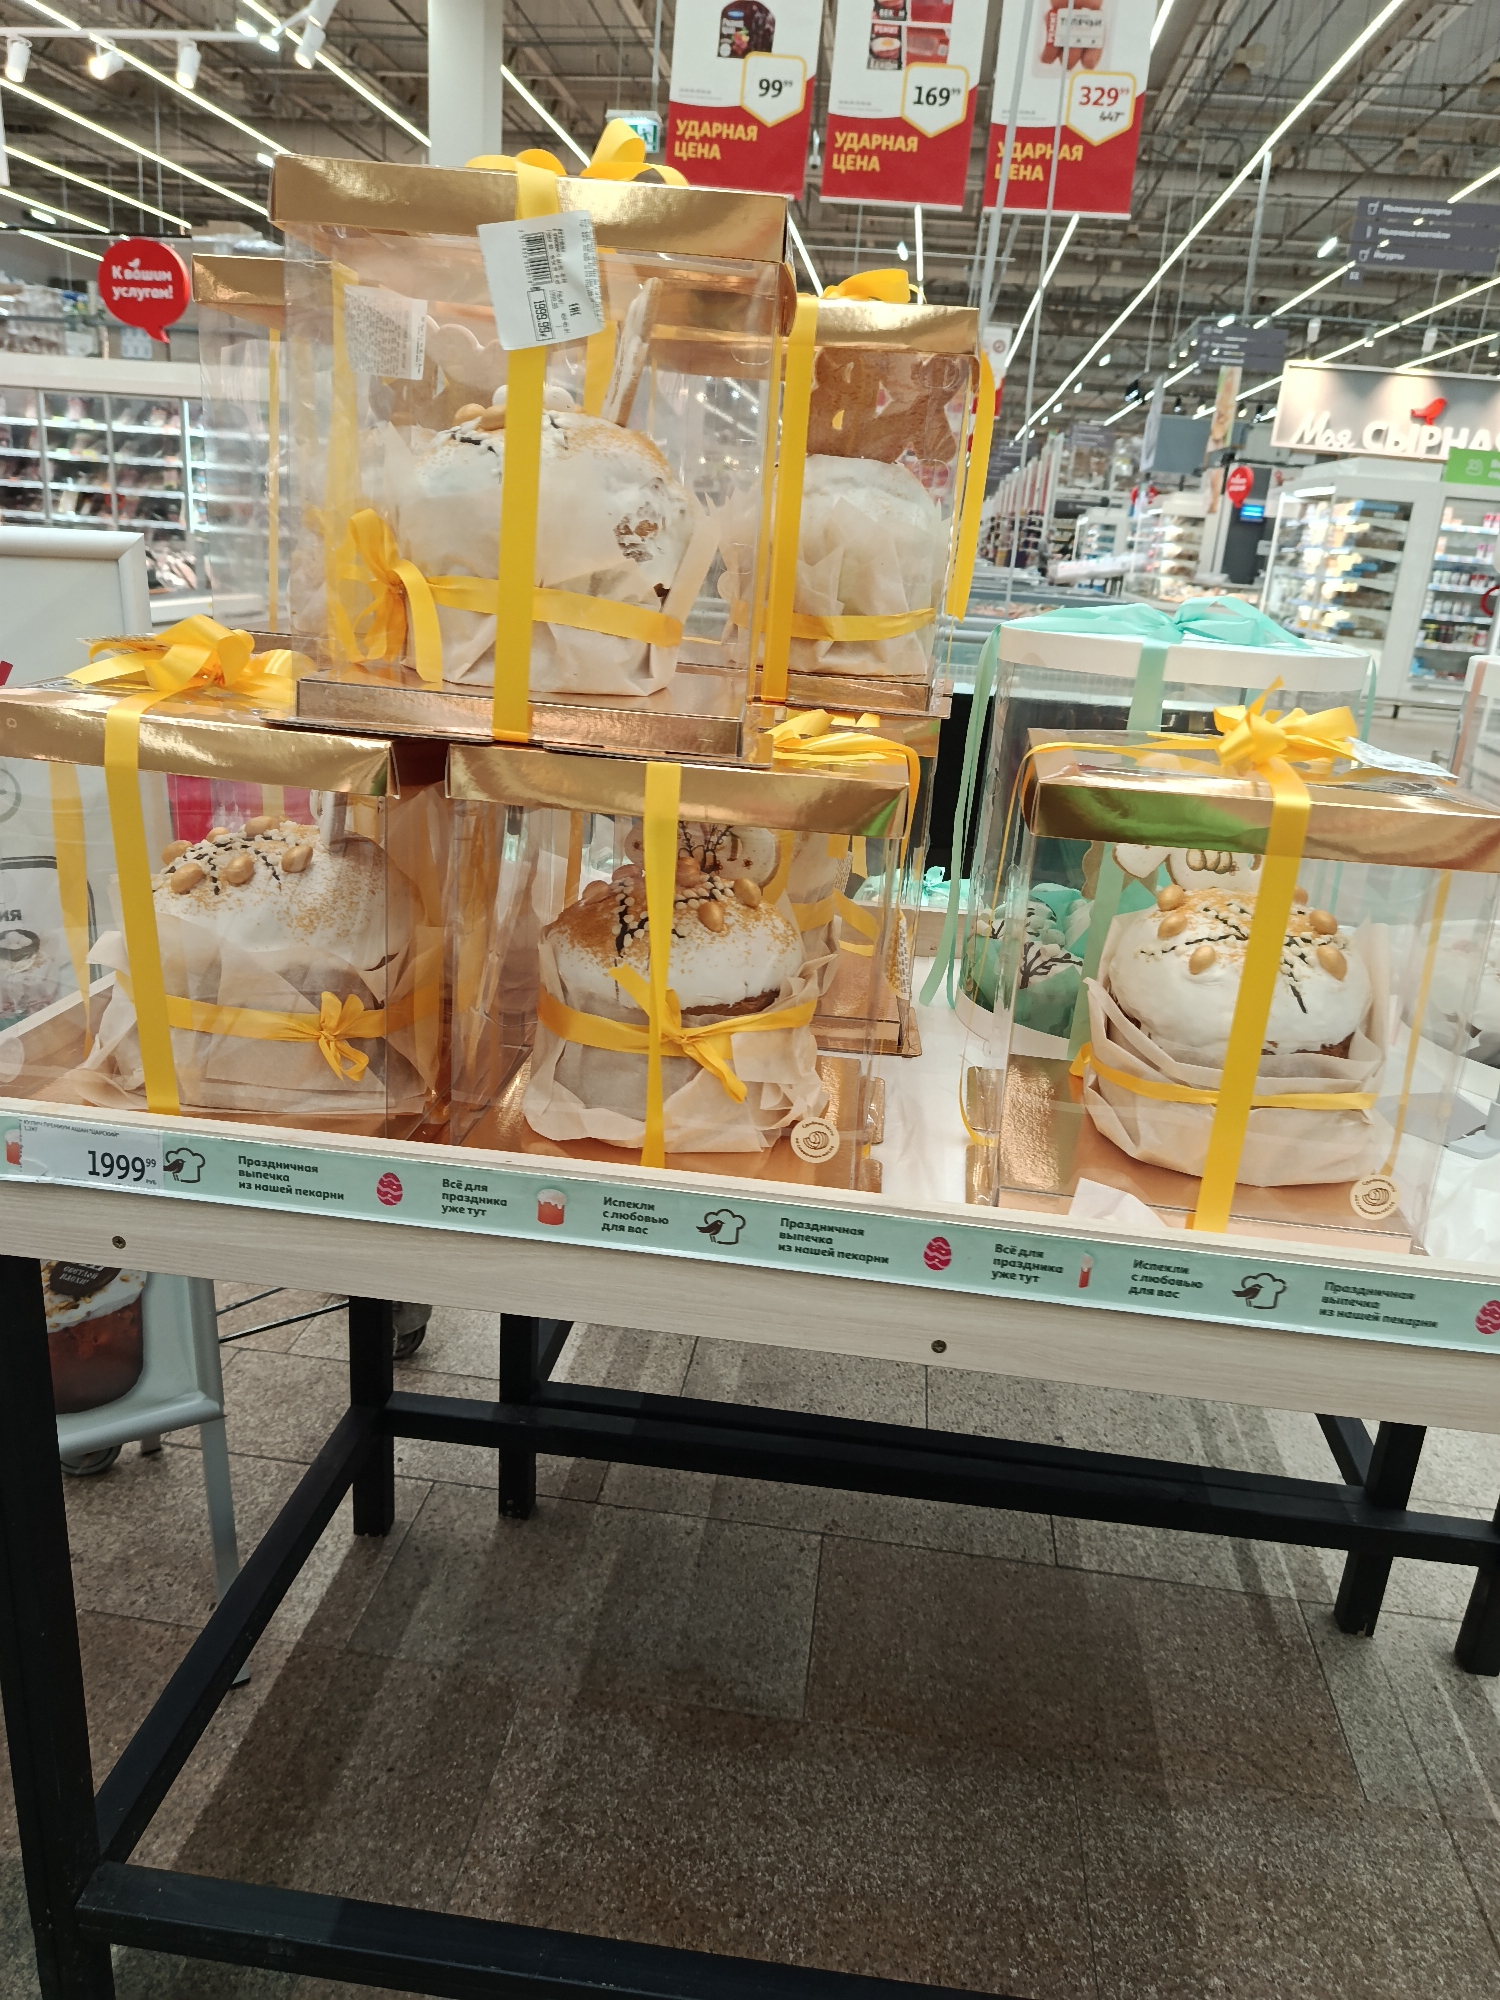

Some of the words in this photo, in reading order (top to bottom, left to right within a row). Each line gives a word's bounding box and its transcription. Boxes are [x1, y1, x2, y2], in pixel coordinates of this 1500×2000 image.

[758, 78, 783, 98] 99
[913, 86, 951, 107] 169
[1079, 86, 1119, 107] 329
[676, 119, 758, 142] УДАРНАЯ
[834, 131, 918, 153] УДАРНАЯ
[674, 140, 721, 161] ЦЕНА
[832, 153, 881, 174] ЦЕНА
[111, 265, 123, 279] К
[124, 269, 172, 281] вашим
[112, 285, 173, 301] услугам!
[1290, 410, 1355, 449] Моя
[43, 1121, 71, 1131] ПРЕМИУМ
[70, 1125, 89, 1134] АШАН
[87, 1150, 146, 1182] 1999
[145, 1158, 157, 1168] 99
[238, 1155, 318, 1173] Праздничная
[238, 1169, 290, 1182] выпечка
[238, 1181, 252, 1190] из
[254, 1183, 293, 1195] нашей
[294, 1188, 344, 1200] пекарни
[442, 1178, 463, 1190] Всё
[464, 1183, 488, 1192] для
[442, 1192, 508, 1207] праздника
[603, 1196, 655, 1211] Испекли
[441, 1204, 465, 1214] уже
[466, 1207, 487, 1218] тут
[602, 1210, 609, 1218] с
[610, 1211, 669, 1225] любовью
[601, 1222, 625, 1232] для
[627, 1225, 649, 1235] вас
[780, 1217, 865, 1236] Праздничная
[779, 1231, 833, 1245] выпечка
[778, 1243, 792, 1252] из
[794, 1245, 835, 1258] нашей
[837, 1250, 889, 1264] пекарни
[994, 1243, 1018, 1255] Всё
[1018, 1249, 1045, 1258] для
[992, 1258, 1064, 1274] праздника
[1132, 1259, 1190, 1274] Испекли
[991, 1270, 1017, 1280] уже
[1018, 1273, 1041, 1284] тут
[1139, 1275, 1204, 1289] любовью
[1128, 1286, 1155, 1296] для
[1157, 1289, 1181, 1299] вас
[1324, 1281, 1416, 1300] Праздничная
[1321, 1296, 1380, 1309] выпечка
[1319, 1308, 1335, 1316] из
[1336, 1310, 1381, 1321] нашей
[1382, 1315, 1438, 1328] пекарни
